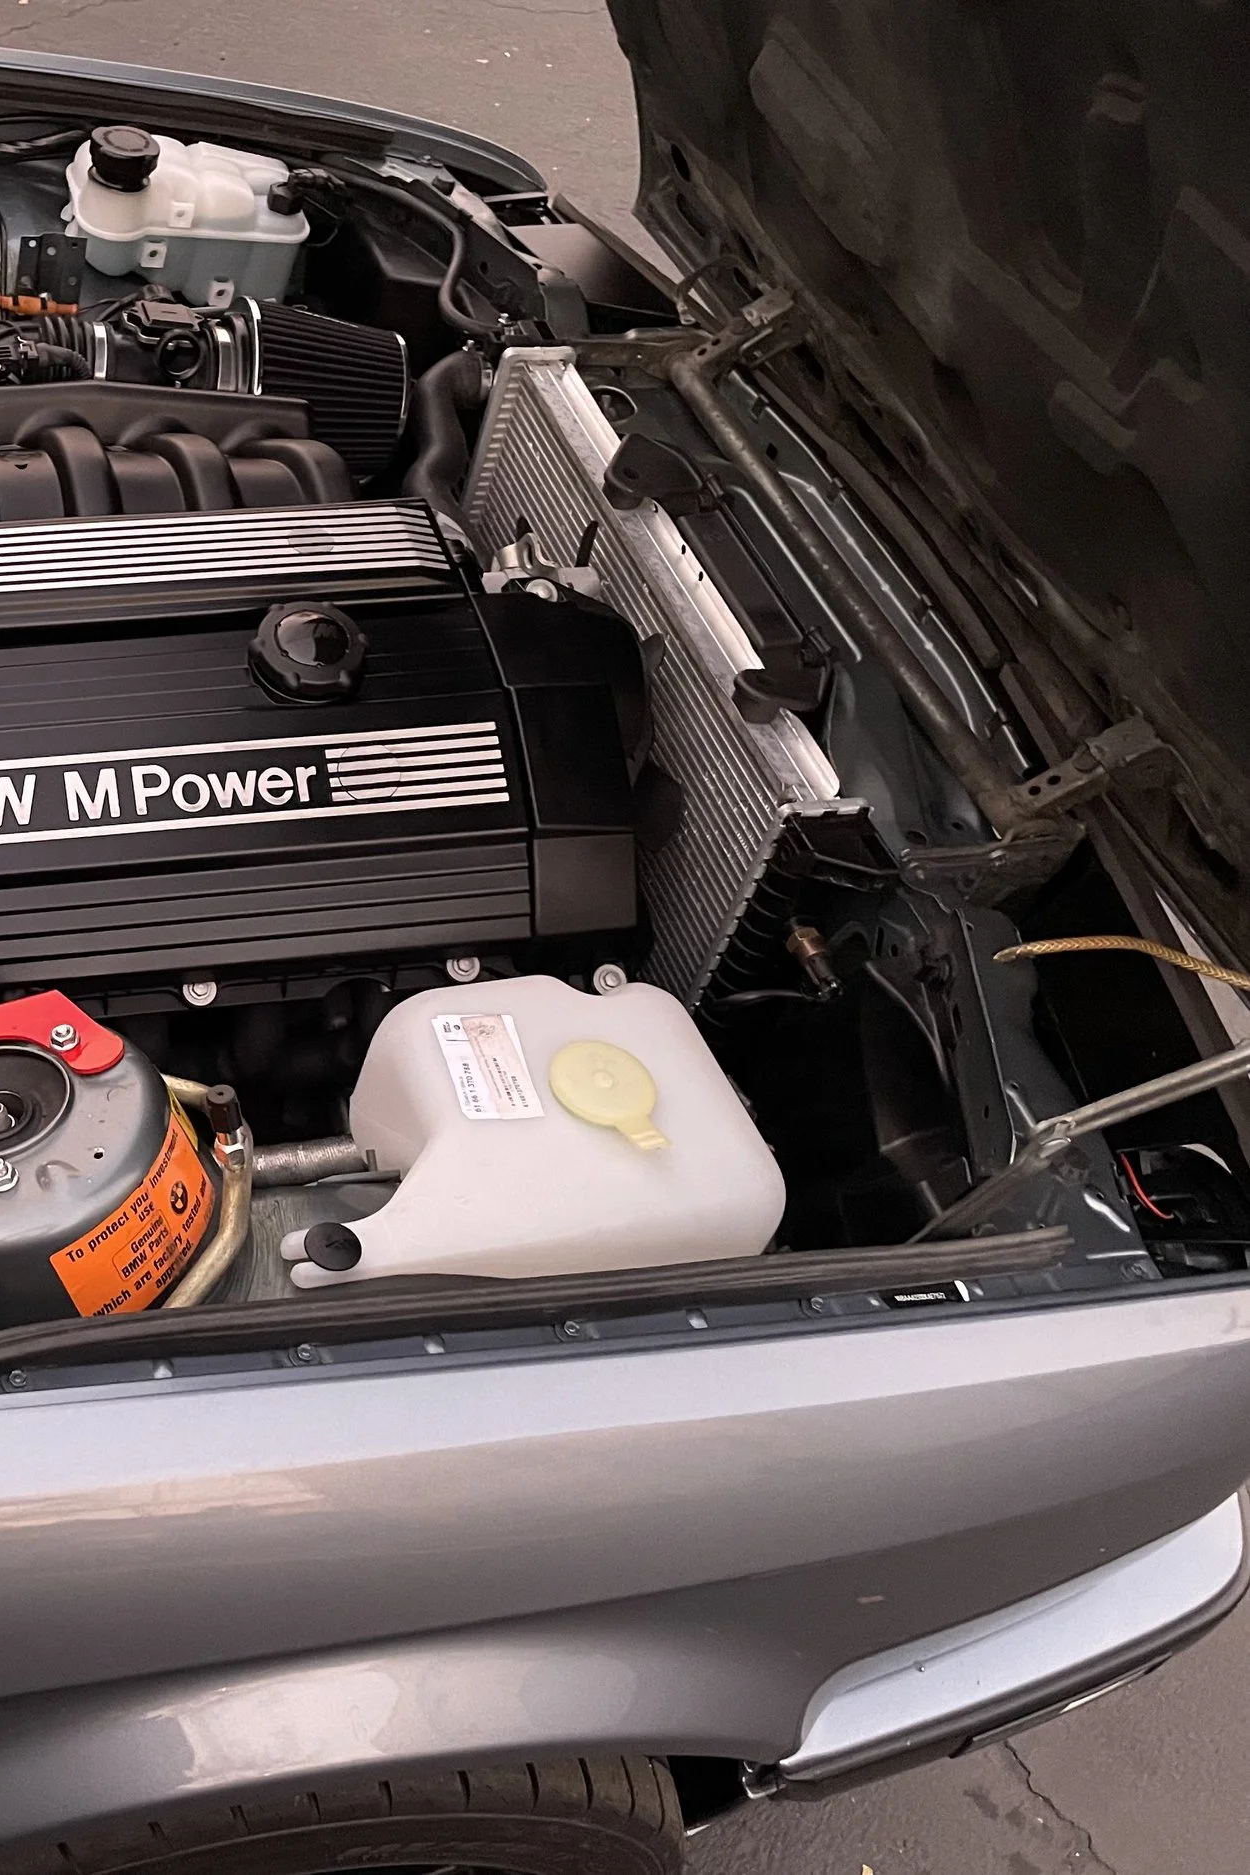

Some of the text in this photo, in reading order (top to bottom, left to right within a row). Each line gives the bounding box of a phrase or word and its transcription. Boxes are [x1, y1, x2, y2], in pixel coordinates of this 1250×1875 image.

[66, 1248, 84, 1262] To
[88, 1211, 129, 1252] protect
[130, 1188, 149, 1214] you
[149, 1128, 178, 1189] investment
[138, 1200, 155, 1222] use
[121, 1227, 168, 1278] BMW Parts
[134, 1270, 152, 1291] are
[182, 1195, 201, 1233] tested
